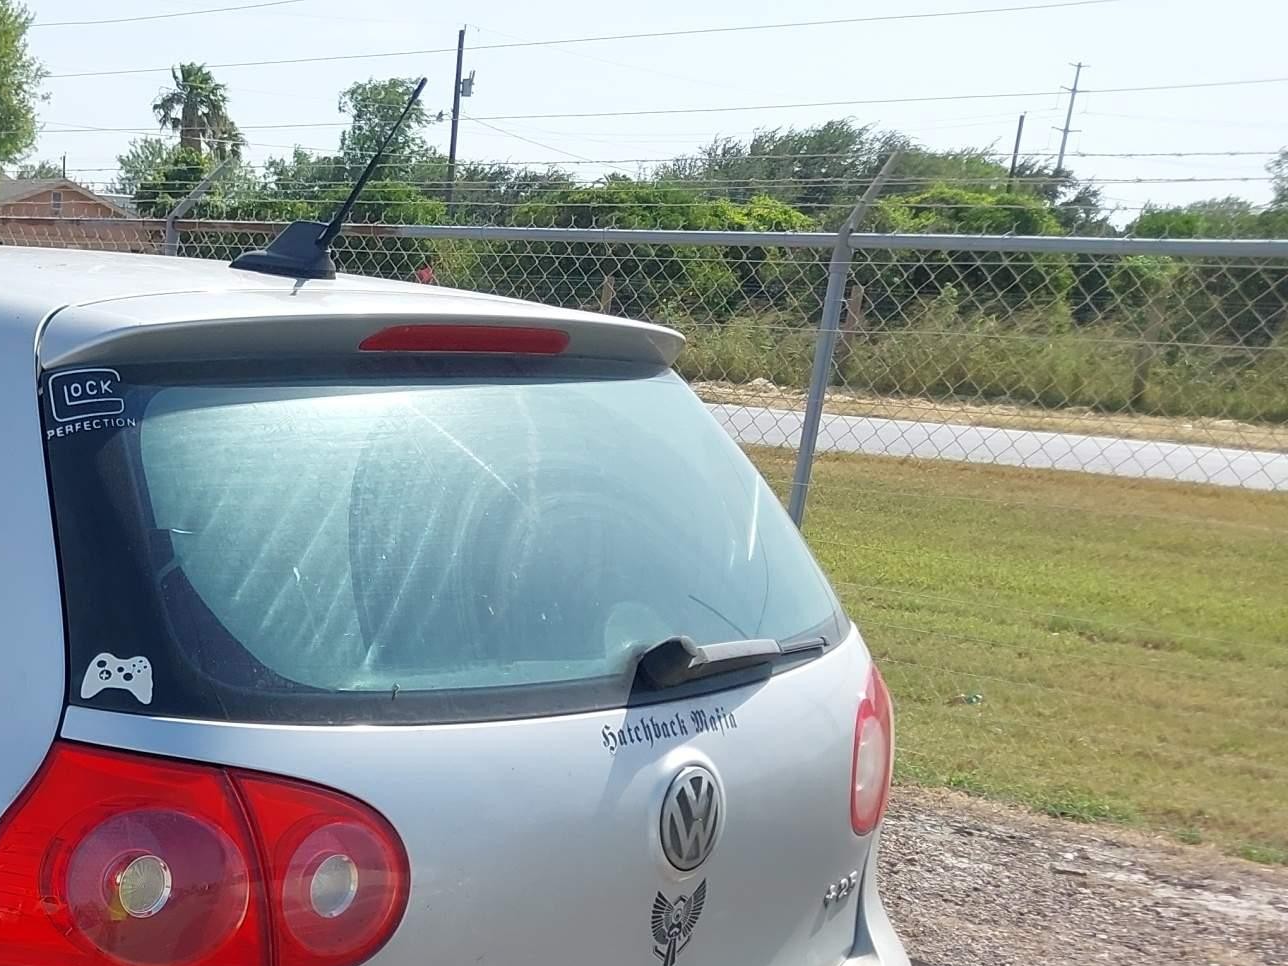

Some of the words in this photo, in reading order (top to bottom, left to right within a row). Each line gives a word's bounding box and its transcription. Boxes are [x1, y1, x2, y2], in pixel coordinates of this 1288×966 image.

[47, 418, 136, 439] PERFECTION
[602, 713, 688, 753] Hatchback
[691, 707, 737, 737] Mafia
